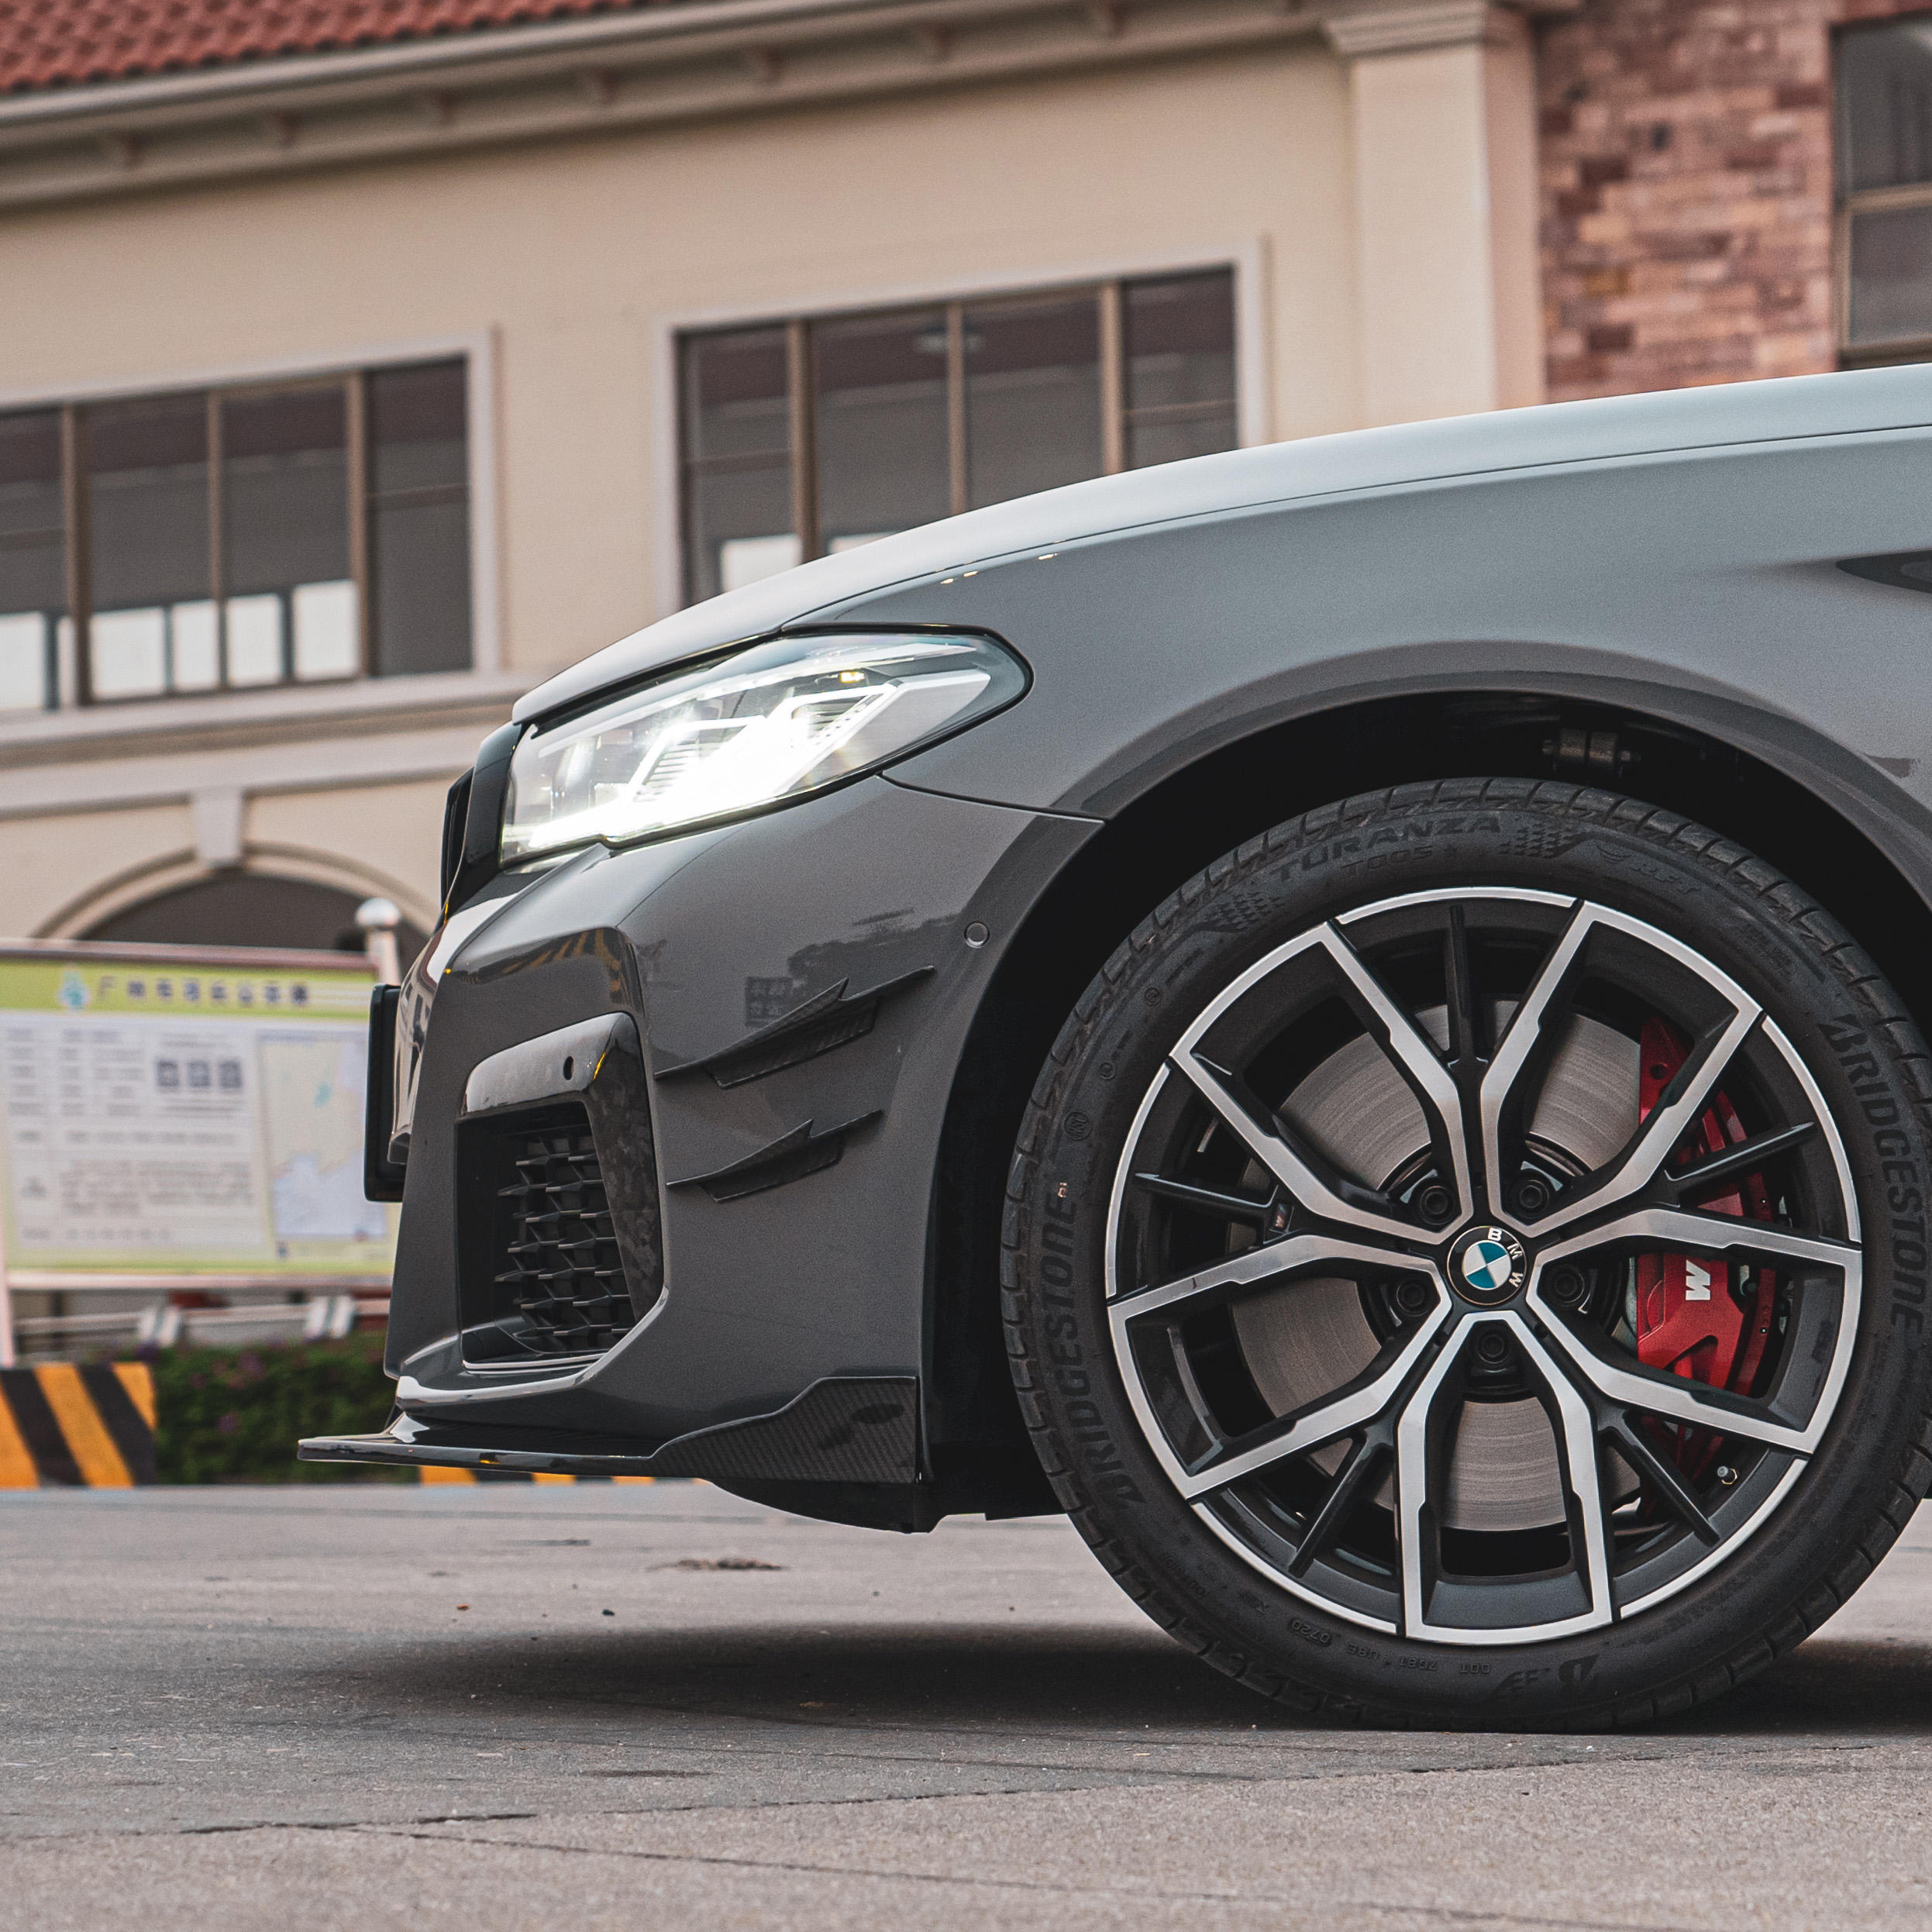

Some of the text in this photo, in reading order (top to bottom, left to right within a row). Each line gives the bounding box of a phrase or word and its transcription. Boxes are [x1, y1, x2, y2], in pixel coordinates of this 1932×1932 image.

[1269, 816, 1501, 881] TURANZA
[1341, 845, 1433, 876] T005
[1817, 1014, 1927, 1334] BRIDGESTONE
[1488, 1228, 1524, 1287] BMW
[1040, 1192, 1146, 1508] BRIDGESTONE
[1291, 1618, 1331, 1644] 0720
[1459, 1662, 1492, 1675] DOT
